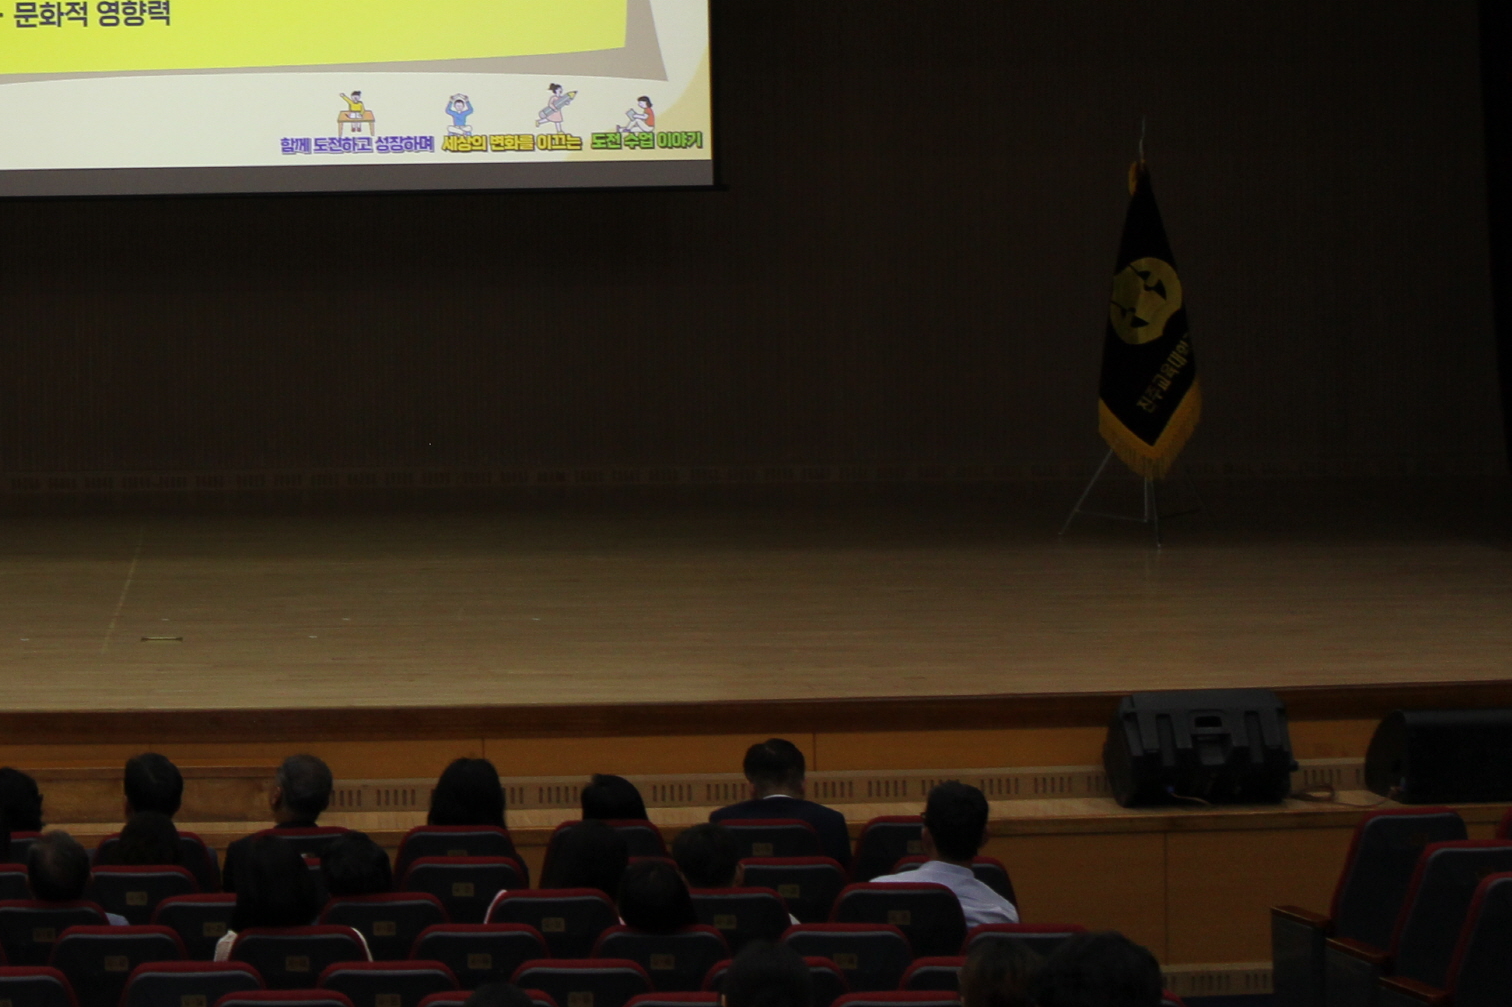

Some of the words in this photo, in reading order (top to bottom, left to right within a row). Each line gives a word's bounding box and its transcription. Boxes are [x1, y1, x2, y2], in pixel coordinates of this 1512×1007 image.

[14, 2, 87, 28] 문화적
[97, 0, 170, 26] 영향력
[280, 137, 311, 154] 함께
[313, 136, 372, 153] 도전하고
[375, 135, 434, 153] 성장하며
[442, 134, 487, 152] 세상의
[489, 134, 534, 151] 변화를
[537, 133, 582, 150] 이끄는
[591, 133, 621, 150] 도전
[623, 132, 654, 149] 수업
[657, 131, 703, 149] 이야기
[1136, 333, 1189, 413] 진주교육대학
